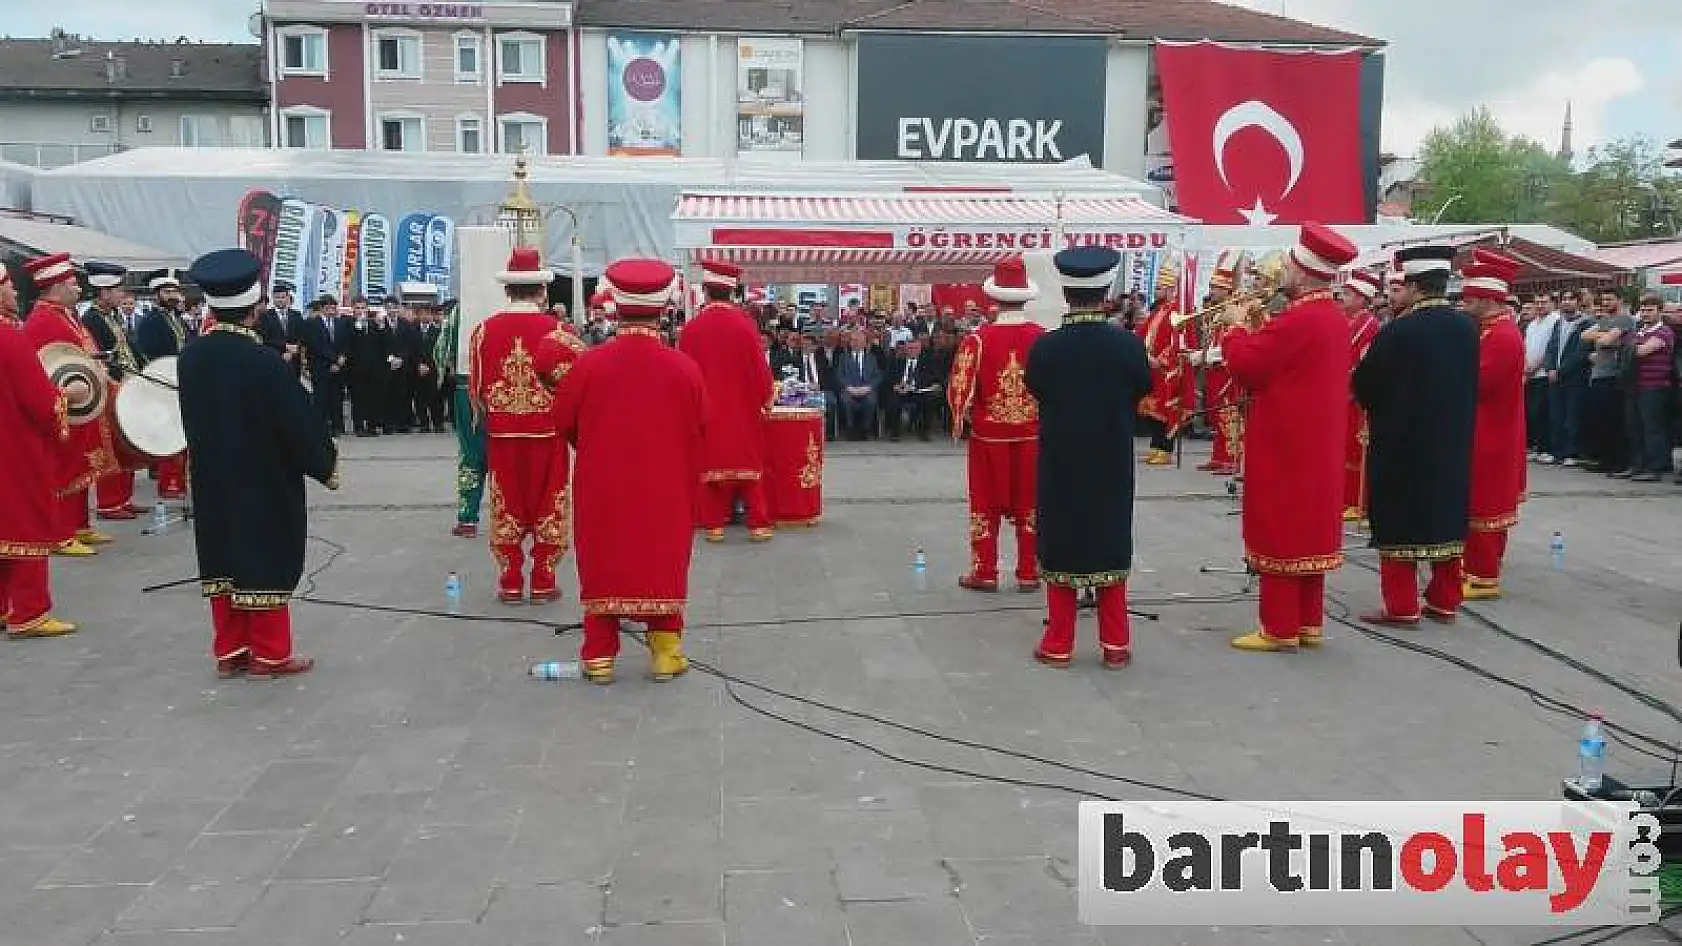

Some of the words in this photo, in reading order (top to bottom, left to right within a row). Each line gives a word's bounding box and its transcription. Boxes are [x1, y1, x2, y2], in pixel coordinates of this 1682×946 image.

[898, 117, 1063, 159] EVPARK
[907, 226, 1052, 249] ÖĞRENCİ
[1063, 232, 1168, 249] YURDU
